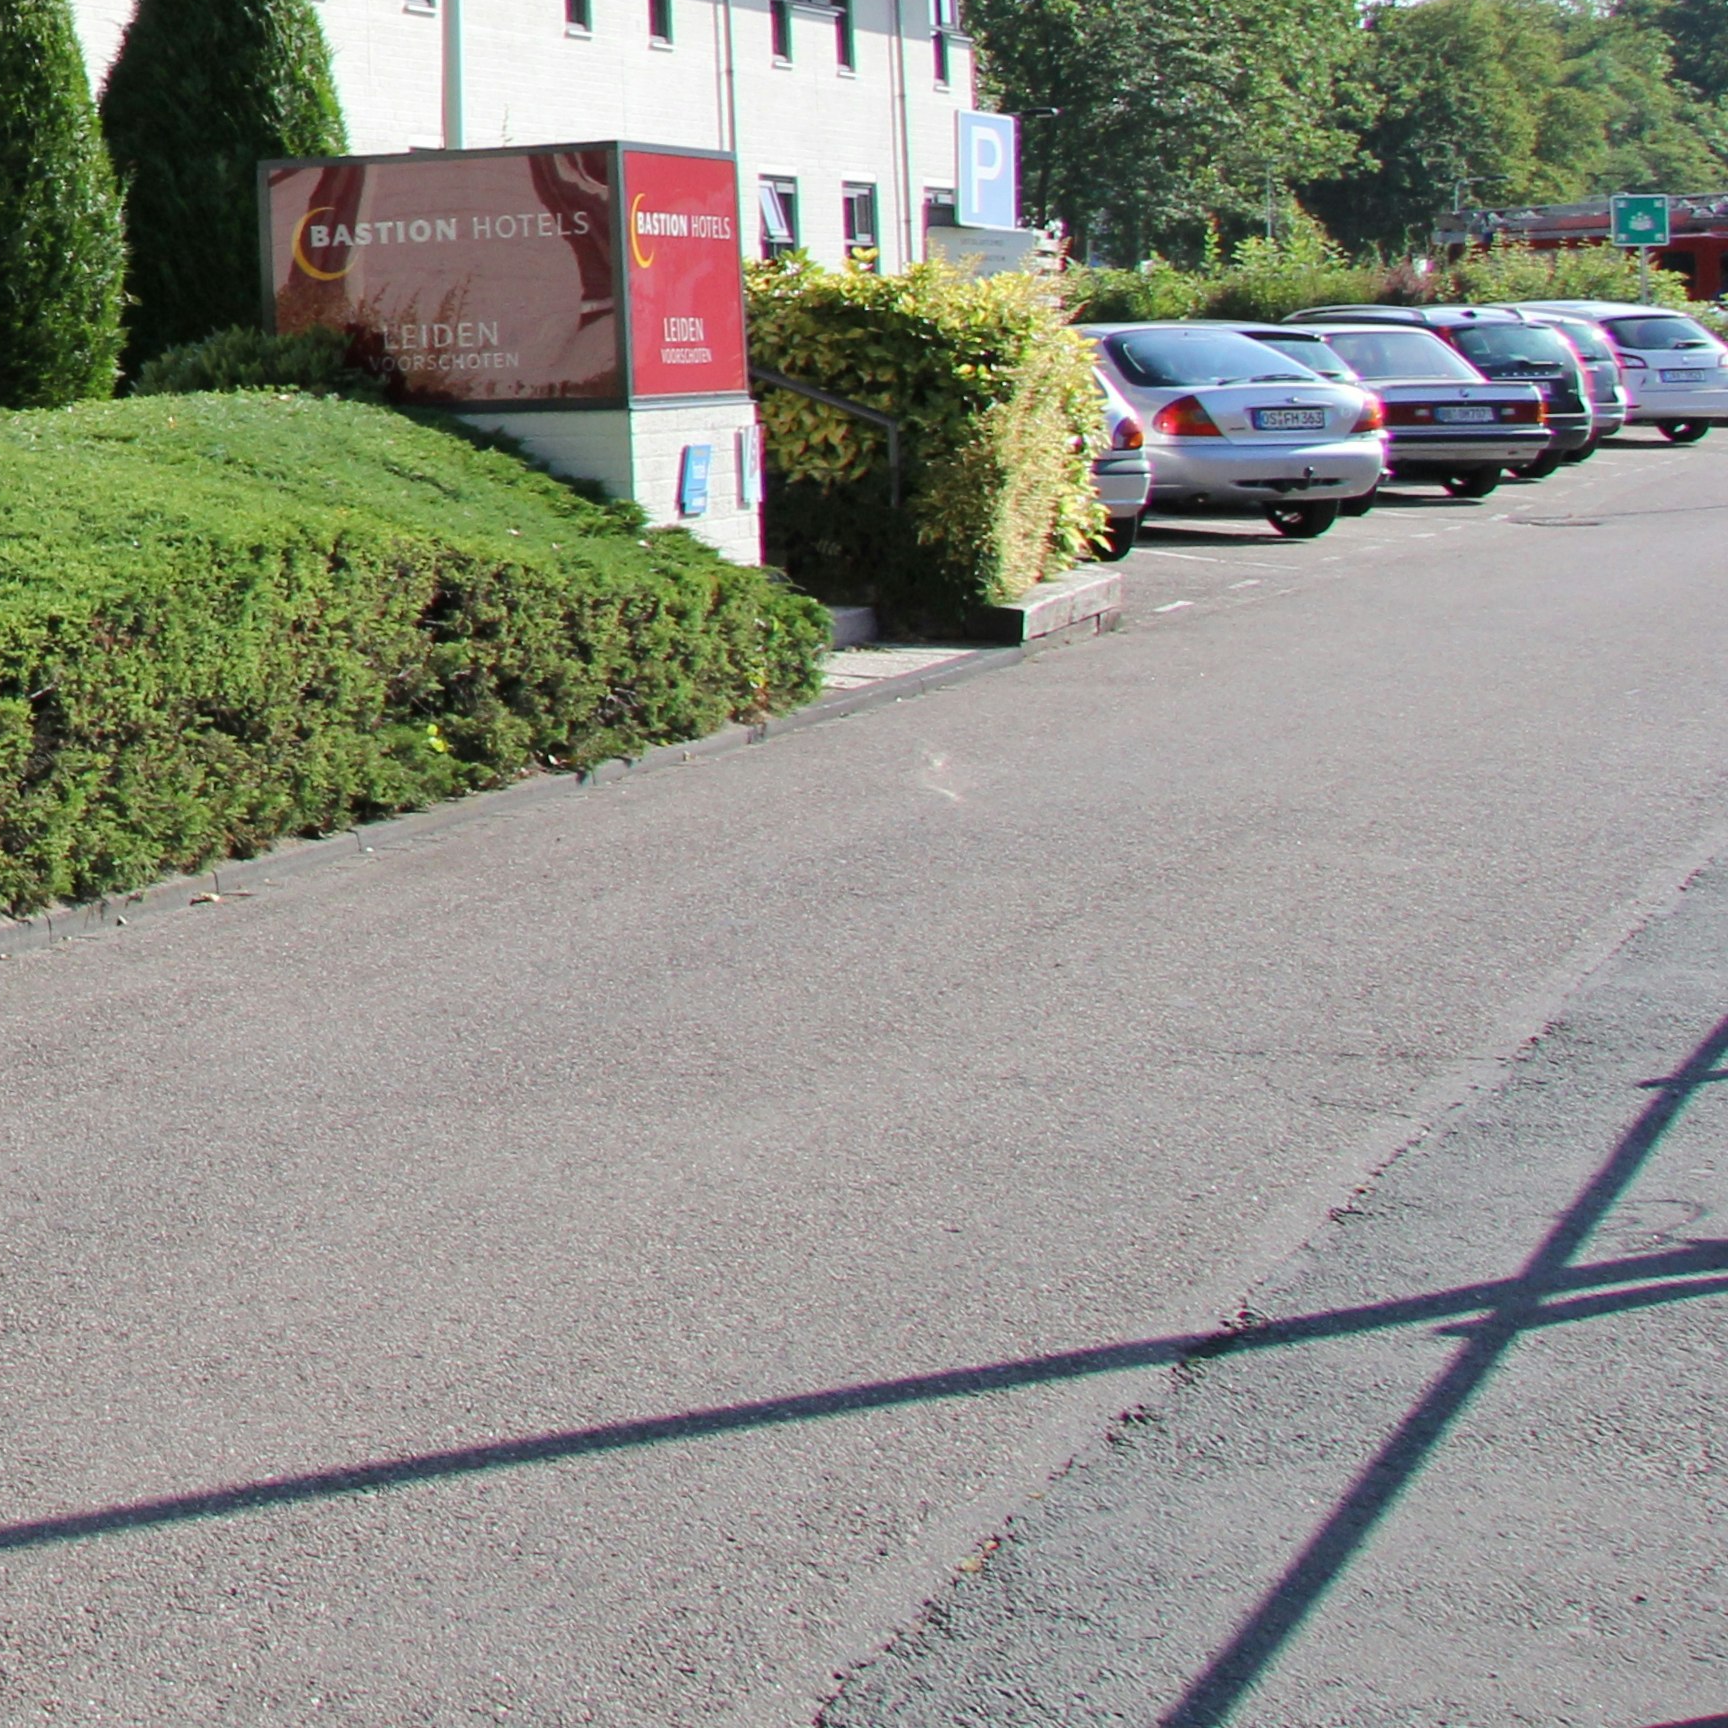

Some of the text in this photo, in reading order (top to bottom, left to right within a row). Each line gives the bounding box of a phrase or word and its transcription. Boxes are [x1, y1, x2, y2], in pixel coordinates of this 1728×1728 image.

[970, 125, 1003, 214] P
[310, 211, 590, 248] BASTION HOTELS
[637, 211, 731, 240] BASTION HOTELS
[383, 321, 500, 350] LEIDEN
[663, 317, 704, 342] LEIDEN
[368, 352, 520, 372] VOORSCHOTEN
[660, 347, 713, 364] VOORSCHOTEN
